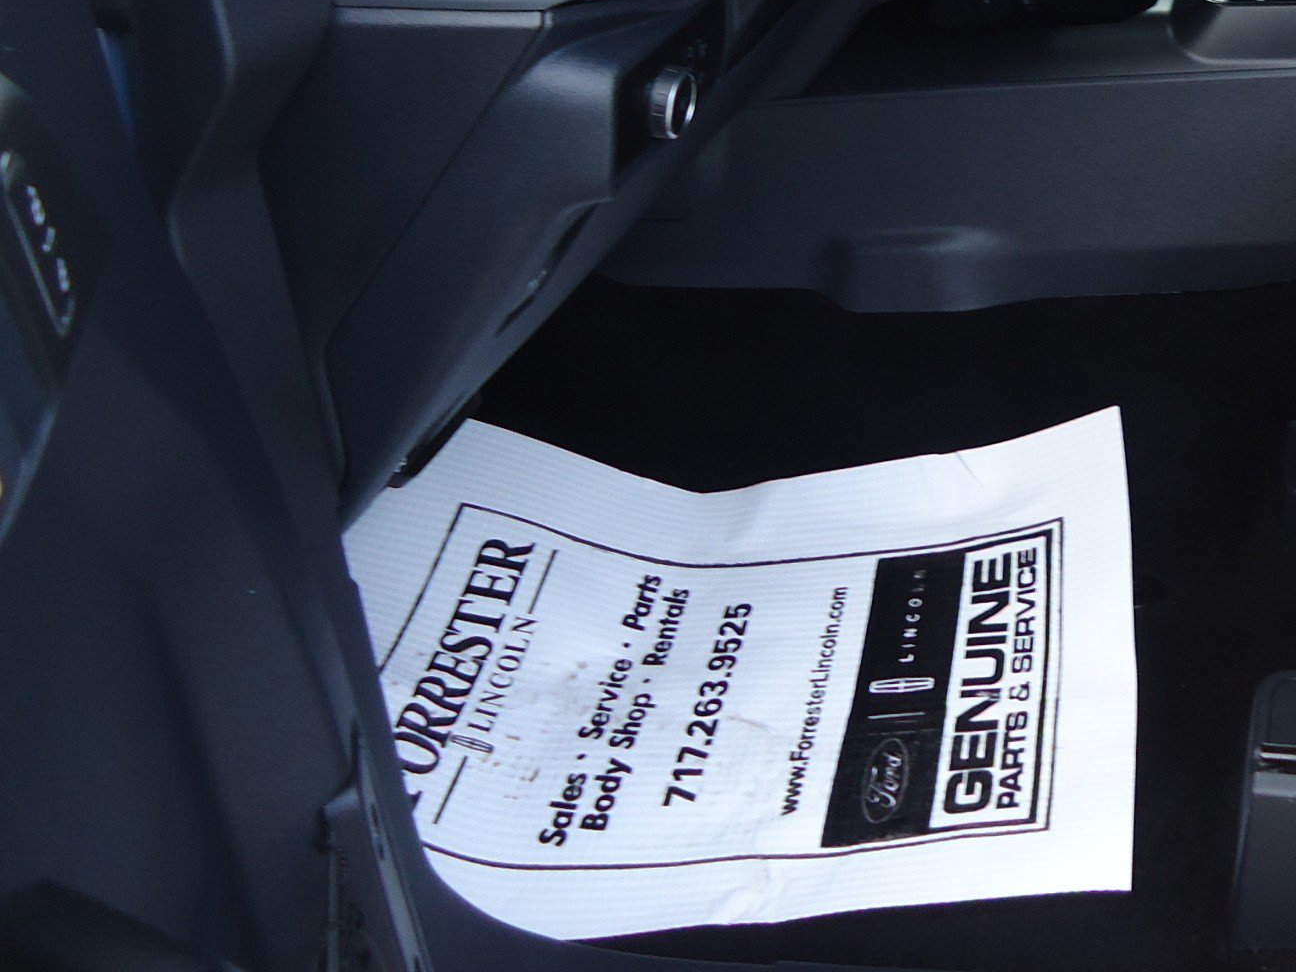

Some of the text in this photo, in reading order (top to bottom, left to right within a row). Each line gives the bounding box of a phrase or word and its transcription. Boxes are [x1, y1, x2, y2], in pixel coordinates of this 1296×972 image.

[394, 538, 536, 810] ORRESTER
[468, 616, 538, 732] LINCOLN
[539, 574, 662, 846] Sales Service Parts
[578, 588, 690, 831] Body Shop Rentals
[662, 602, 753, 807] 717.263.9525
[780, 585, 849, 816] www.ForresterLincoln.com
[865, 751, 903, 809] Ford
[943, 551, 1013, 815] GENUINE
[996, 546, 1038, 810] PARTS & SERVICE
